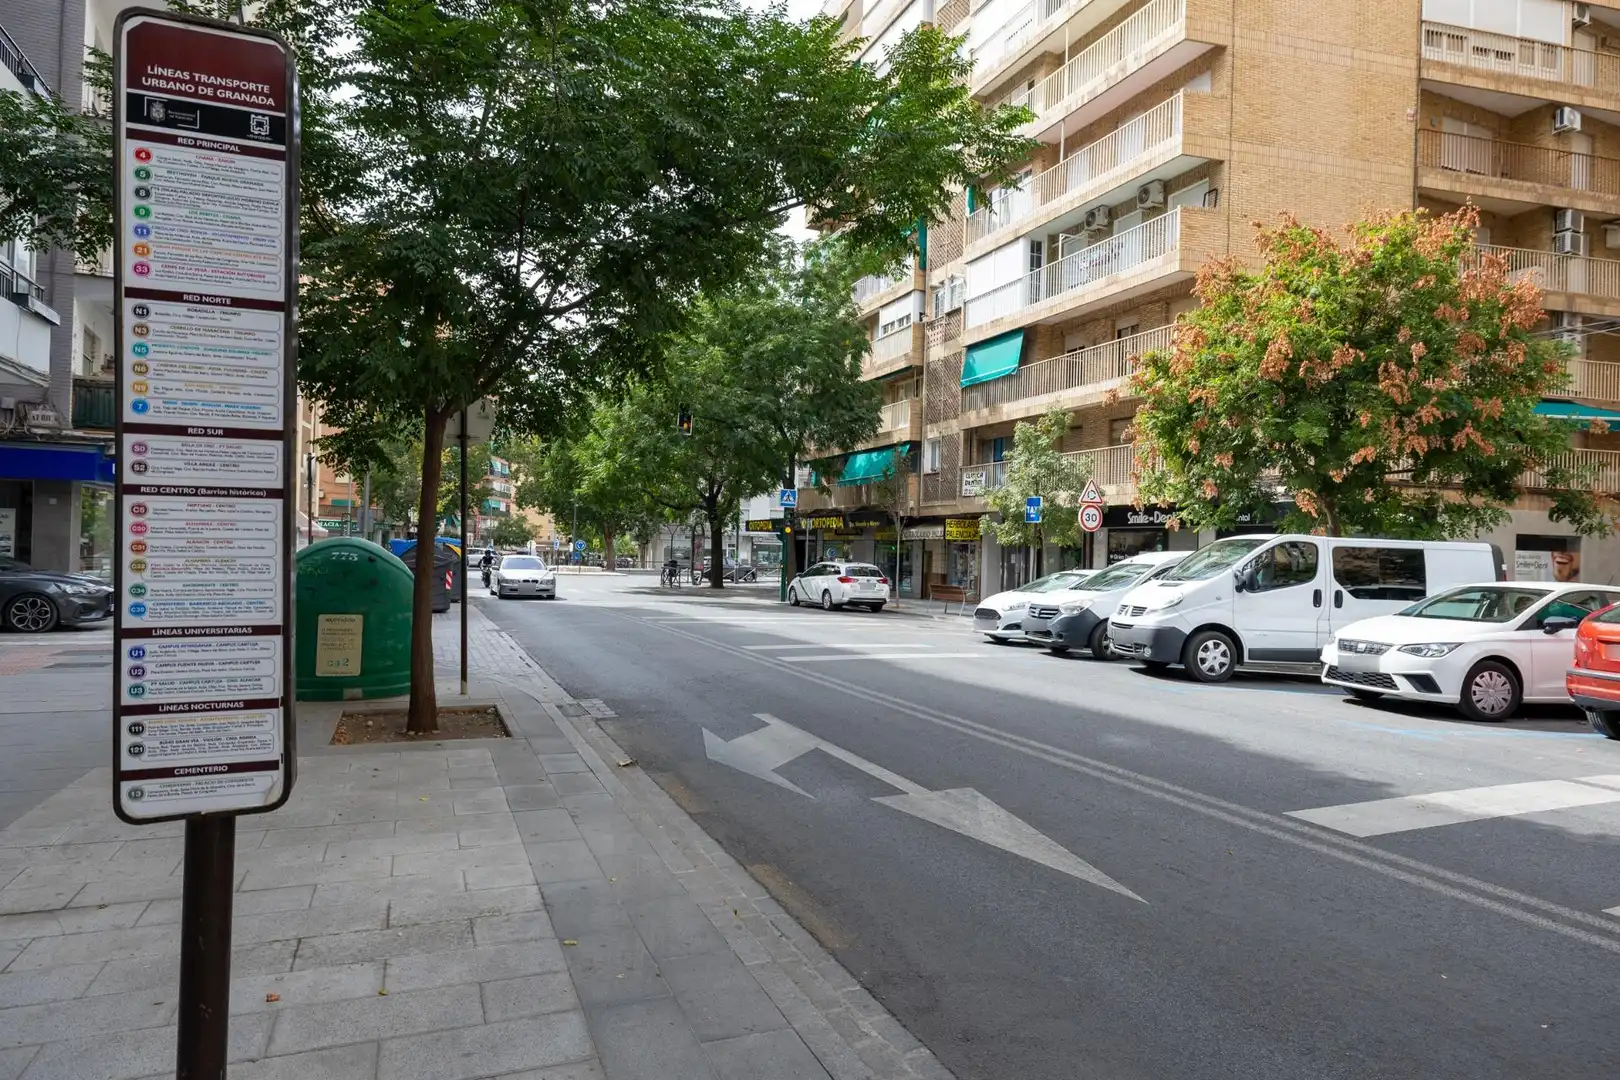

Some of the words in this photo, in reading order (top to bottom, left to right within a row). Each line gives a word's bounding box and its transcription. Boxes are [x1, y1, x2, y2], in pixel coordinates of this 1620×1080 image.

[148, 64, 190, 80] LÍNEAS
[192, 72, 270, 94] TRANSPORTE
[142, 77, 195, 92] URBANO
[198, 86, 214, 96] DE
[216, 89, 276, 106] GRANADA
[178, 137, 194, 146] RED
[196, 140, 240, 152] PRINCIPAL
[202, 296, 232, 304] NORTE
[188, 427, 204, 435] RED
[206, 428, 224, 436] SUR
[160, 487, 196, 495] CENTRO
[198, 487, 228, 496] (Barrios
[229, 488, 267, 497] históricos)
[1084, 512, 1098, 522] 30
[749, 521, 772, 532] ORTOPEDIA
[810, 517, 844, 530] ORTOPEDIA
[946, 520, 980, 528] HERBOLARIO
[330, 552, 358, 562] 773
[152, 628, 182, 636] LÍNEAS
[184, 626, 253, 635] UNIVERSITARIAS
[159, 704, 190, 712] LÍNEAS
[191, 702, 244, 710] NOCTURNAS
[130, 724, 144, 732] 111
[130, 746, 144, 754] 121
[174, 765, 228, 776] CEMENTERIO
